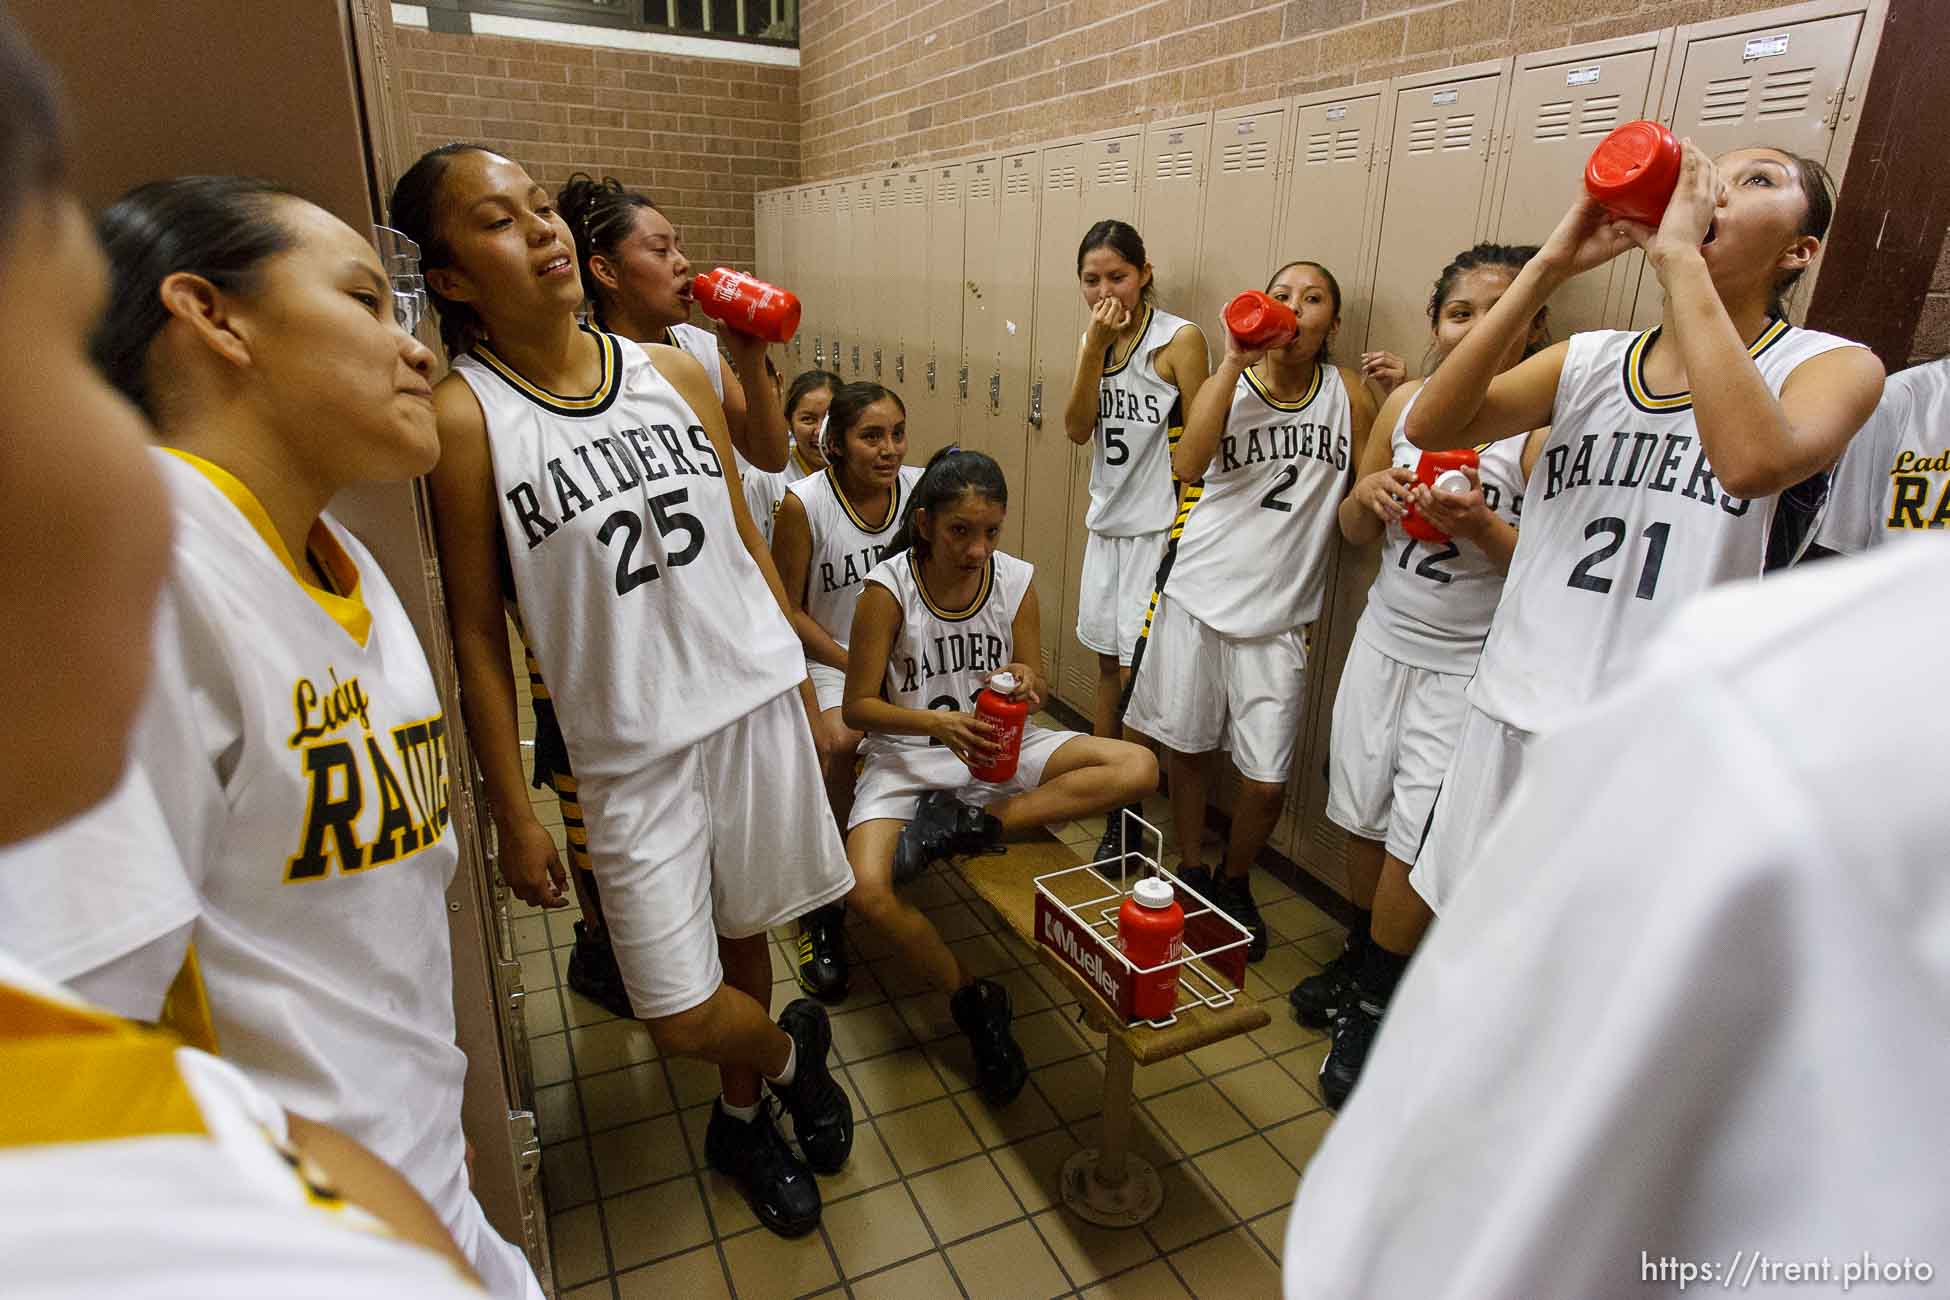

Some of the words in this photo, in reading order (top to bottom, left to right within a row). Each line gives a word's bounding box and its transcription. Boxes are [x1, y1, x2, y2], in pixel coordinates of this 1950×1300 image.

[1098, 389, 1161, 424] DERS
[1105, 428, 1130, 466] 5
[1220, 422, 1349, 473] RAIDERS
[506, 424, 723, 550] RAIDERS
[1260, 464, 1299, 512] 2
[597, 487, 706, 597] 25
[1567, 516, 1671, 600] 21
[901, 632, 1009, 692] RAIDER
[1053, 920, 1120, 1001] Mueller
